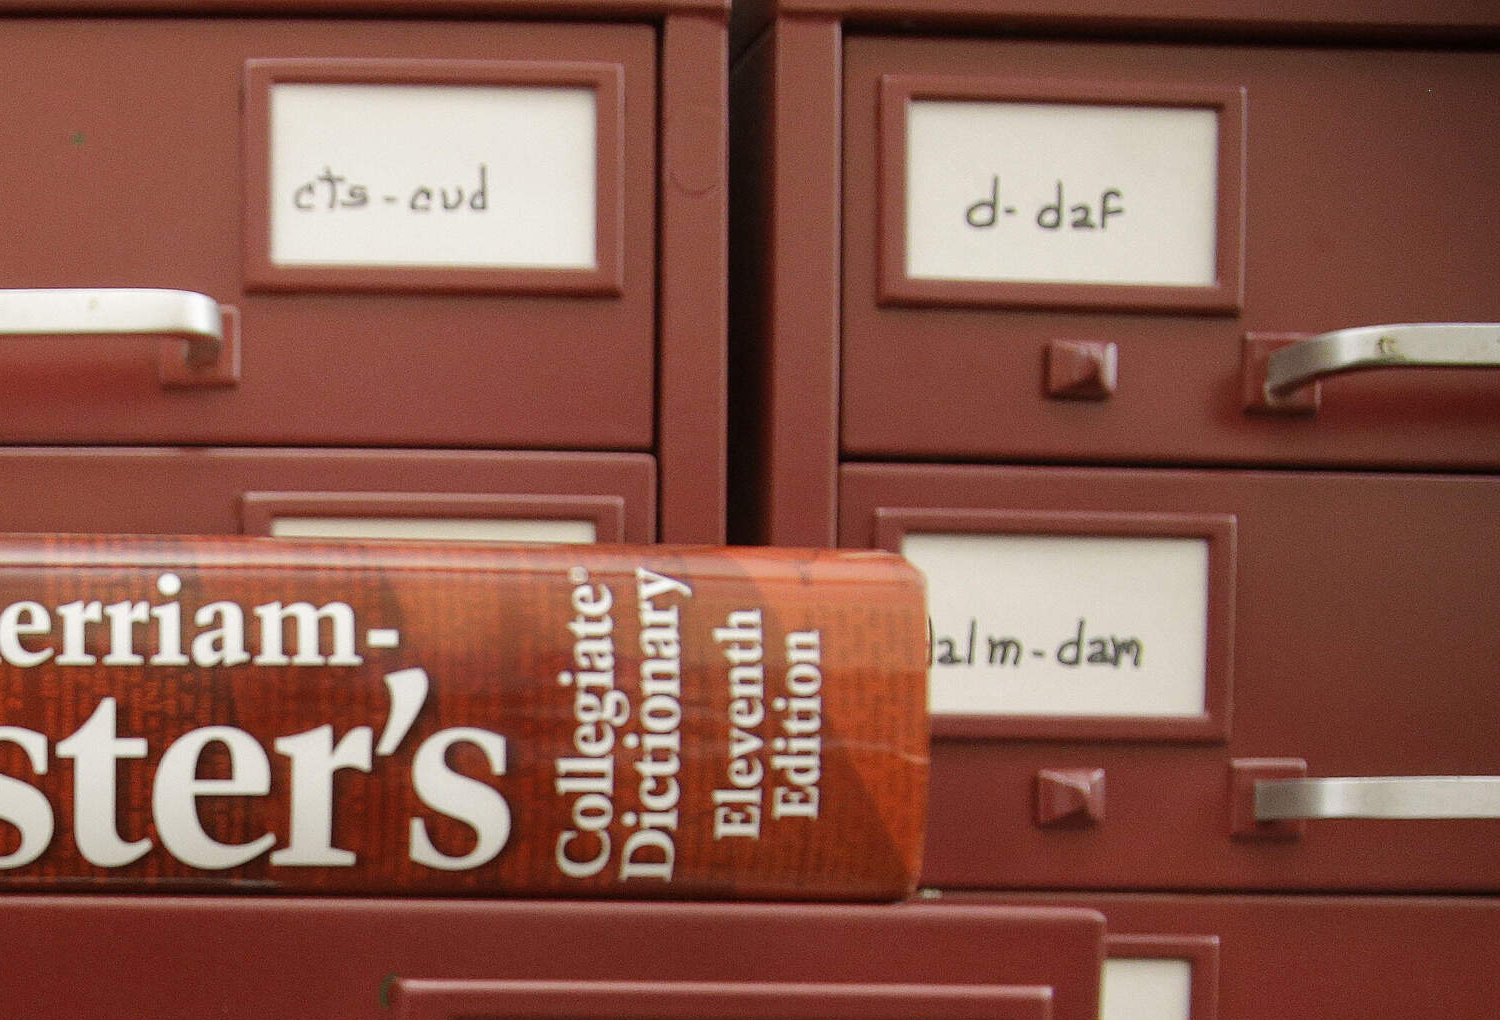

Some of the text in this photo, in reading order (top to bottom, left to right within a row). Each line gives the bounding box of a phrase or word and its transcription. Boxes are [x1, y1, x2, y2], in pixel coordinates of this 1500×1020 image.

[618, 567, 693, 882] Dictionary
[712, 608, 765, 840] Eleventh
[771, 629, 823, 820] Edition
[928, 616, 1145, 670] alm-dam
